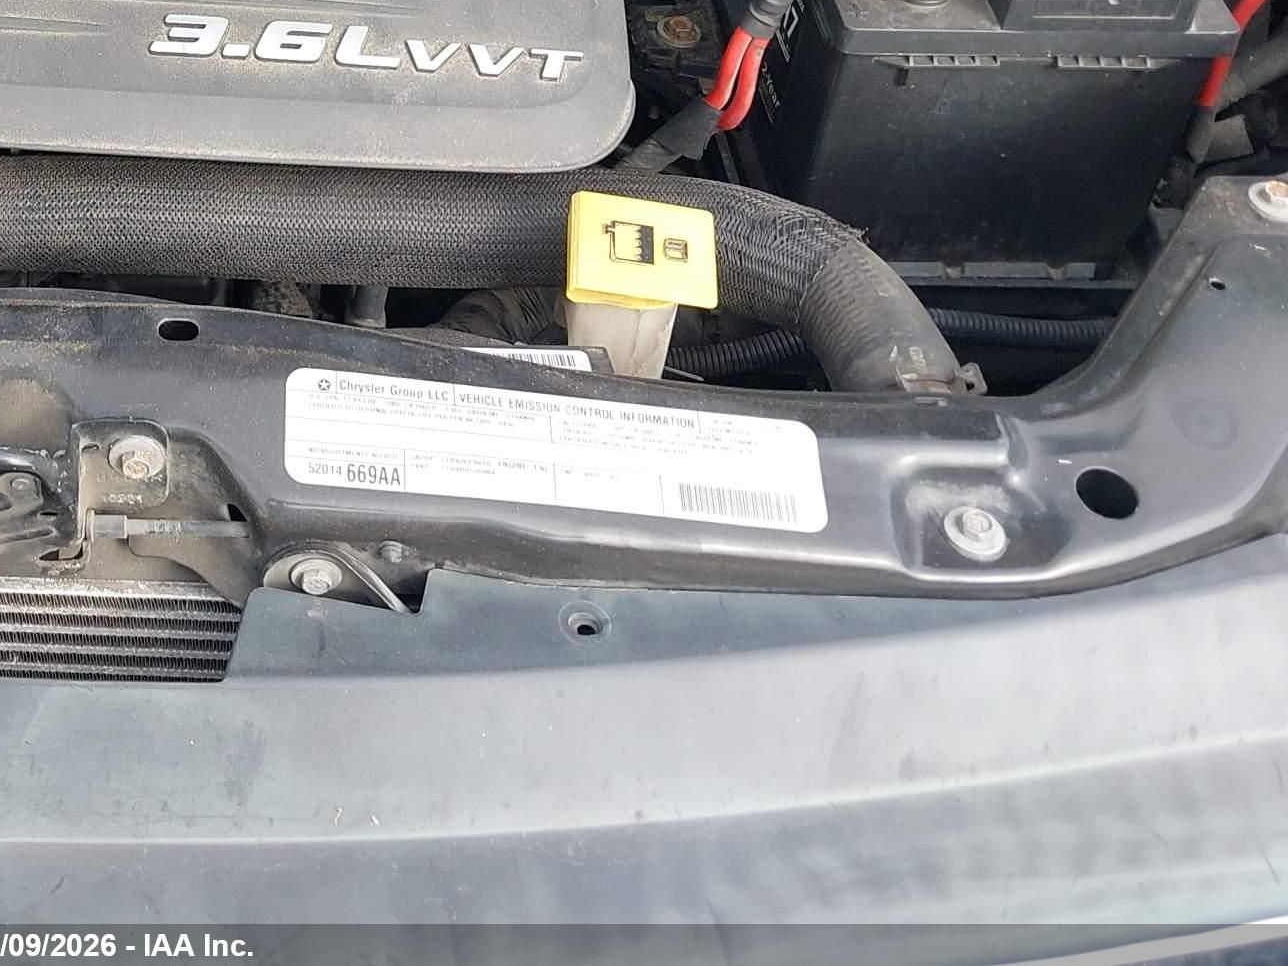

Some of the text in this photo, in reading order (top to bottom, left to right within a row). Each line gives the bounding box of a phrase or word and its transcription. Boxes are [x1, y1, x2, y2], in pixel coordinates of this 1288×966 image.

[404, 38, 585, 83] VVT
[761, 61, 782, 109] 2-Year
[339, 378, 450, 402] Chrysler Group LLC
[459, 393, 503, 408] VEHICLE
[508, 398, 561, 414] EMISSION
[565, 404, 615, 420] CONTROL
[620, 411, 695, 430] INFORMATION
[308, 461, 342, 475] 52014
[347, 463, 401, 486] 669AA
